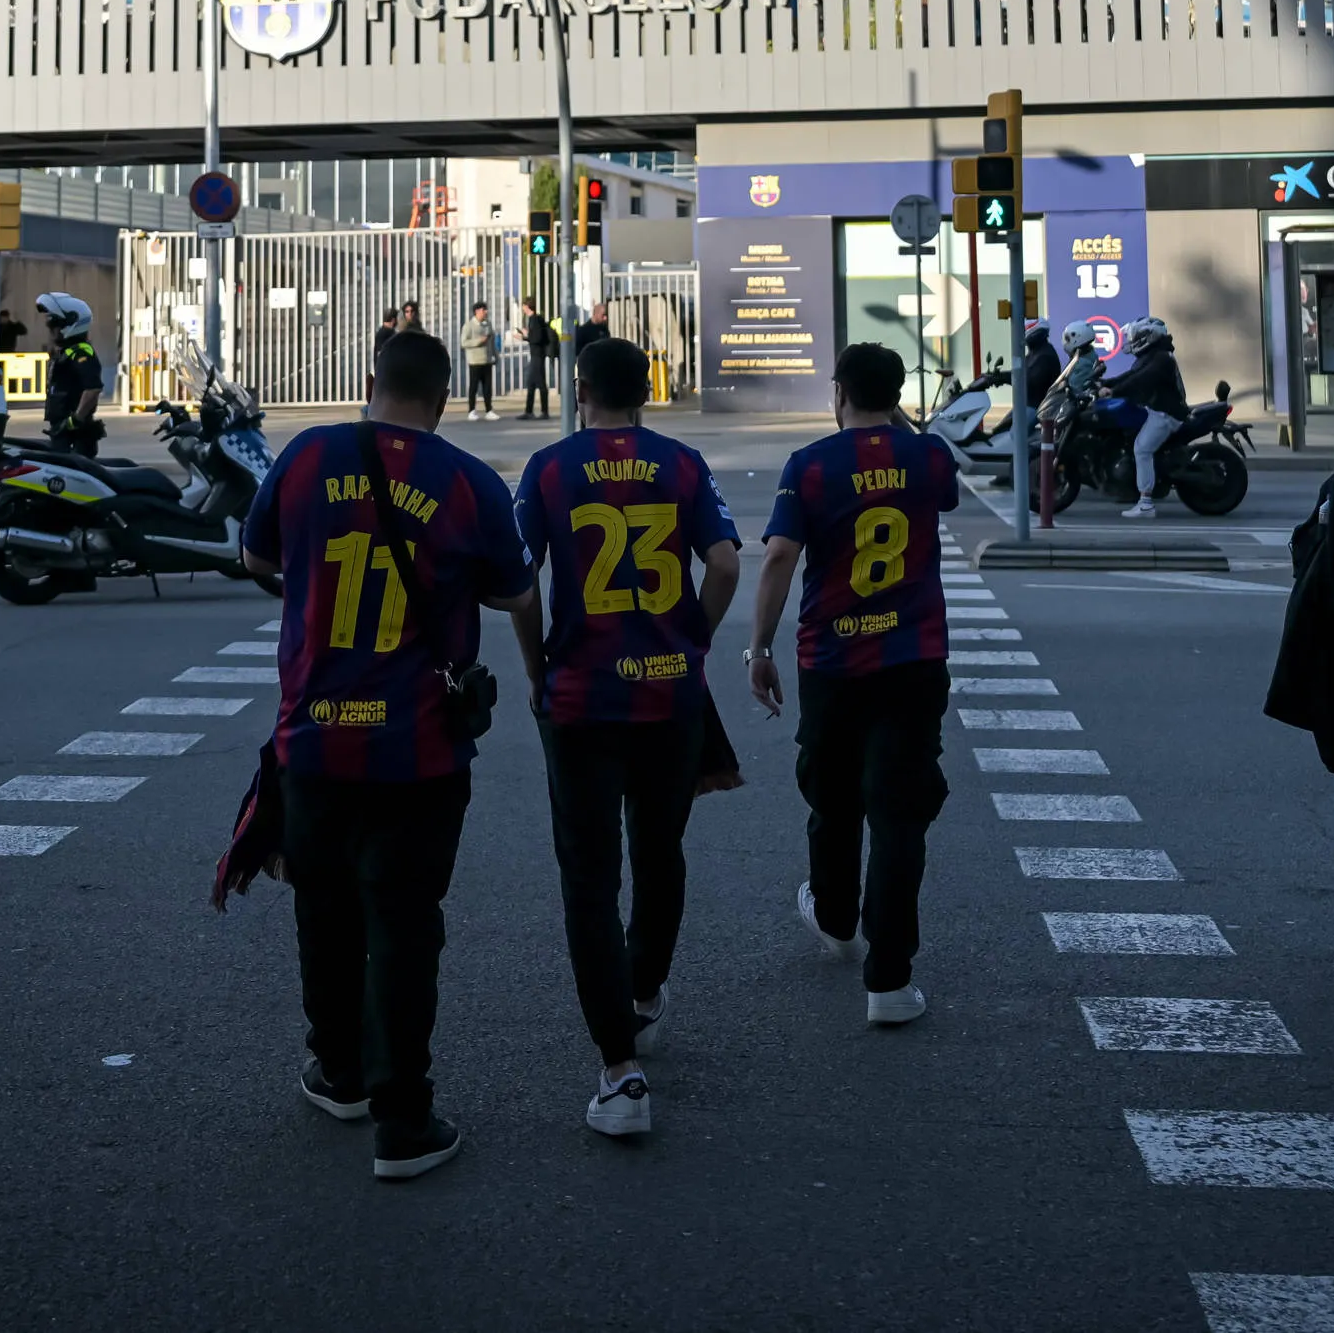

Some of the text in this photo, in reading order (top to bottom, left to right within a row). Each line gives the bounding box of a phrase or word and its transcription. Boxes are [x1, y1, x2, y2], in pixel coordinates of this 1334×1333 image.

[1072, 234, 1123, 254] ACCÉS
[1076, 264, 1120, 299] 15
[737, 308, 769, 320] BARÇA
[720, 333, 753, 344] PALAU
[583, 458, 660, 484] KOUNDE
[851, 468, 907, 495] PEDRI
[570, 503, 682, 615] 23
[850, 506, 909, 598] 8
[325, 531, 417, 653] 11
[860, 611, 898, 624] UNHCR
[860, 619, 898, 632] ACNUR
[644, 653, 687, 667] UNHCR
[646, 663, 688, 677] ACNUR
[340, 700, 387, 712] UNHCR
[338, 711, 387, 722] ACNUR
